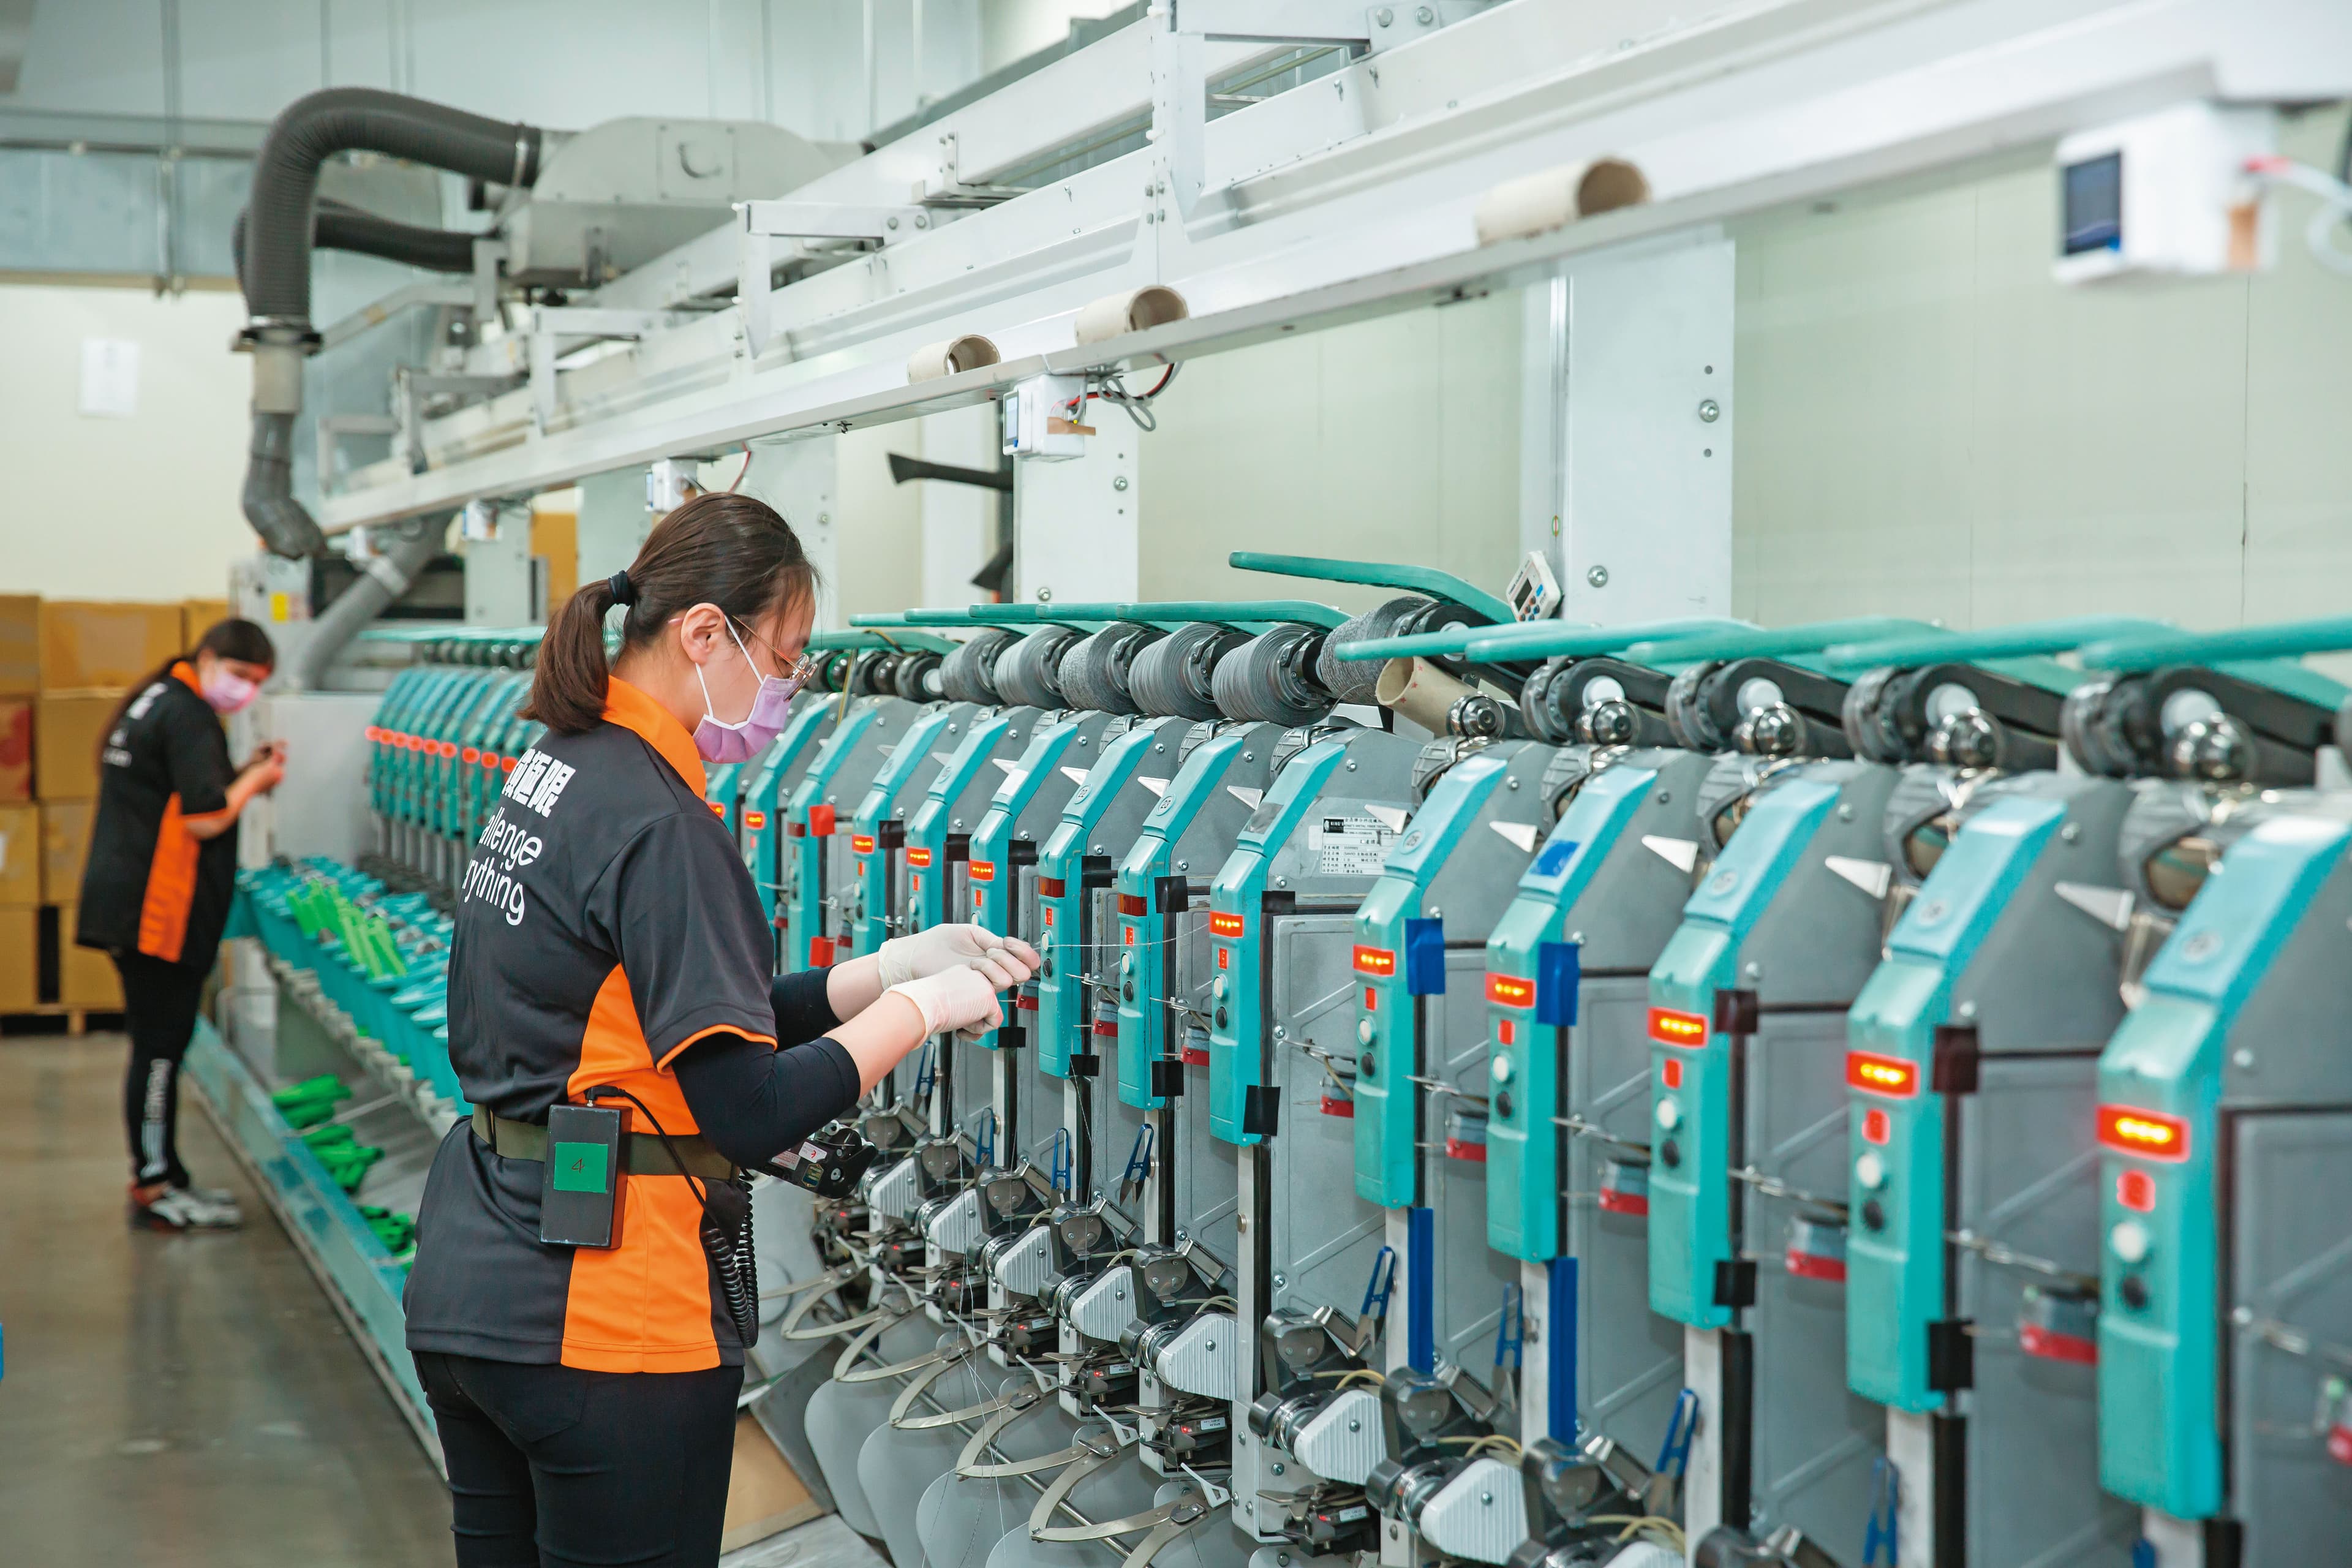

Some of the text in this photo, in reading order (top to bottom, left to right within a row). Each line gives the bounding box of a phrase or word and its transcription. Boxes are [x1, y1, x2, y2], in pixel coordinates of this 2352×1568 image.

[501, 748, 576, 818] 戰極限
[479, 807, 542, 871] allenge
[462, 857, 525, 925] rything
[571, 1158, 585, 1174] 4
